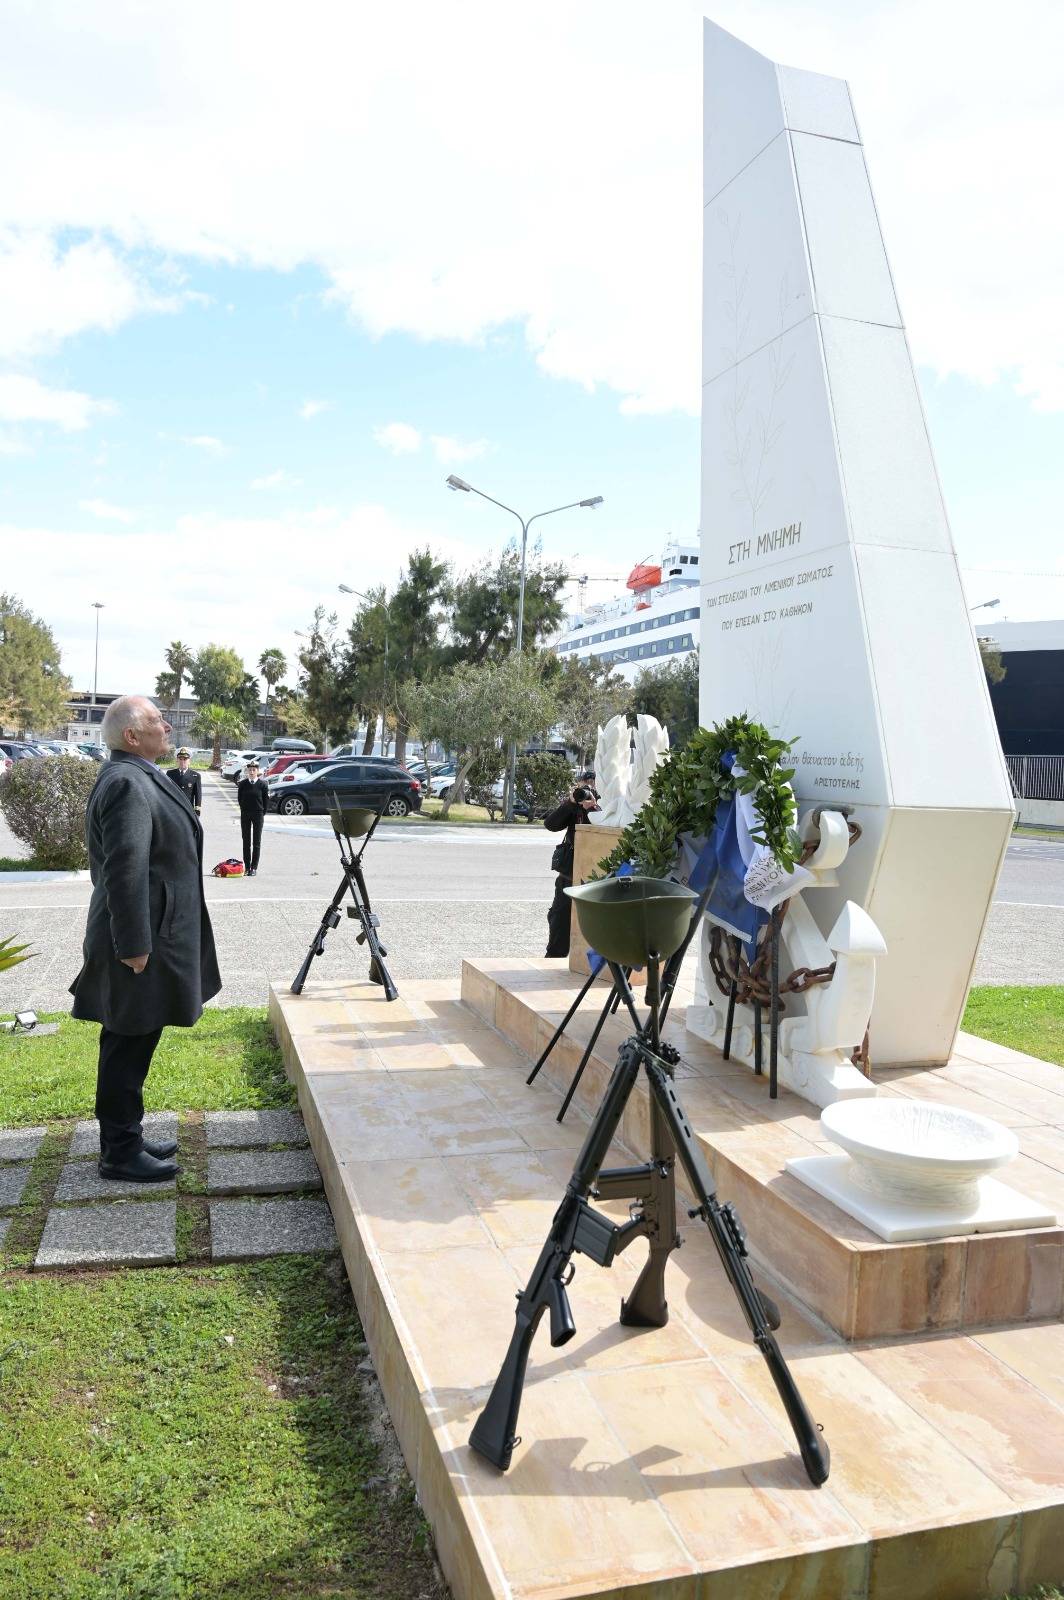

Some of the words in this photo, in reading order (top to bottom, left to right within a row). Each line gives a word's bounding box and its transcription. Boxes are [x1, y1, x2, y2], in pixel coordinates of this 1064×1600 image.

[728, 540, 751, 565] ΣΤΗ
[757, 522, 802, 556] ΜΝΗΜΗ
[706, 597, 717, 609] ΤΩΝ
[718, 589, 748, 606] ΣΤΕΛΕΧΩΝ
[750, 585, 762, 597] ΤΟΥ
[764, 577, 795, 593] ΛΙΜΕΝΙΚΟΥ
[797, 565, 834, 585] ΣΩΜΑΤΟΣ
[721, 620, 734, 631] ΠΟΥ
[735, 614, 760, 628] ΕΠΕΣΑΝ
[763, 611, 776, 622] ΣΤΟ
[780, 602, 814, 619] ΚΑΘΗΚΟΝ
[813, 777, 860, 788] ΑΡΙΣΤΟΤΕΛΗΣ
